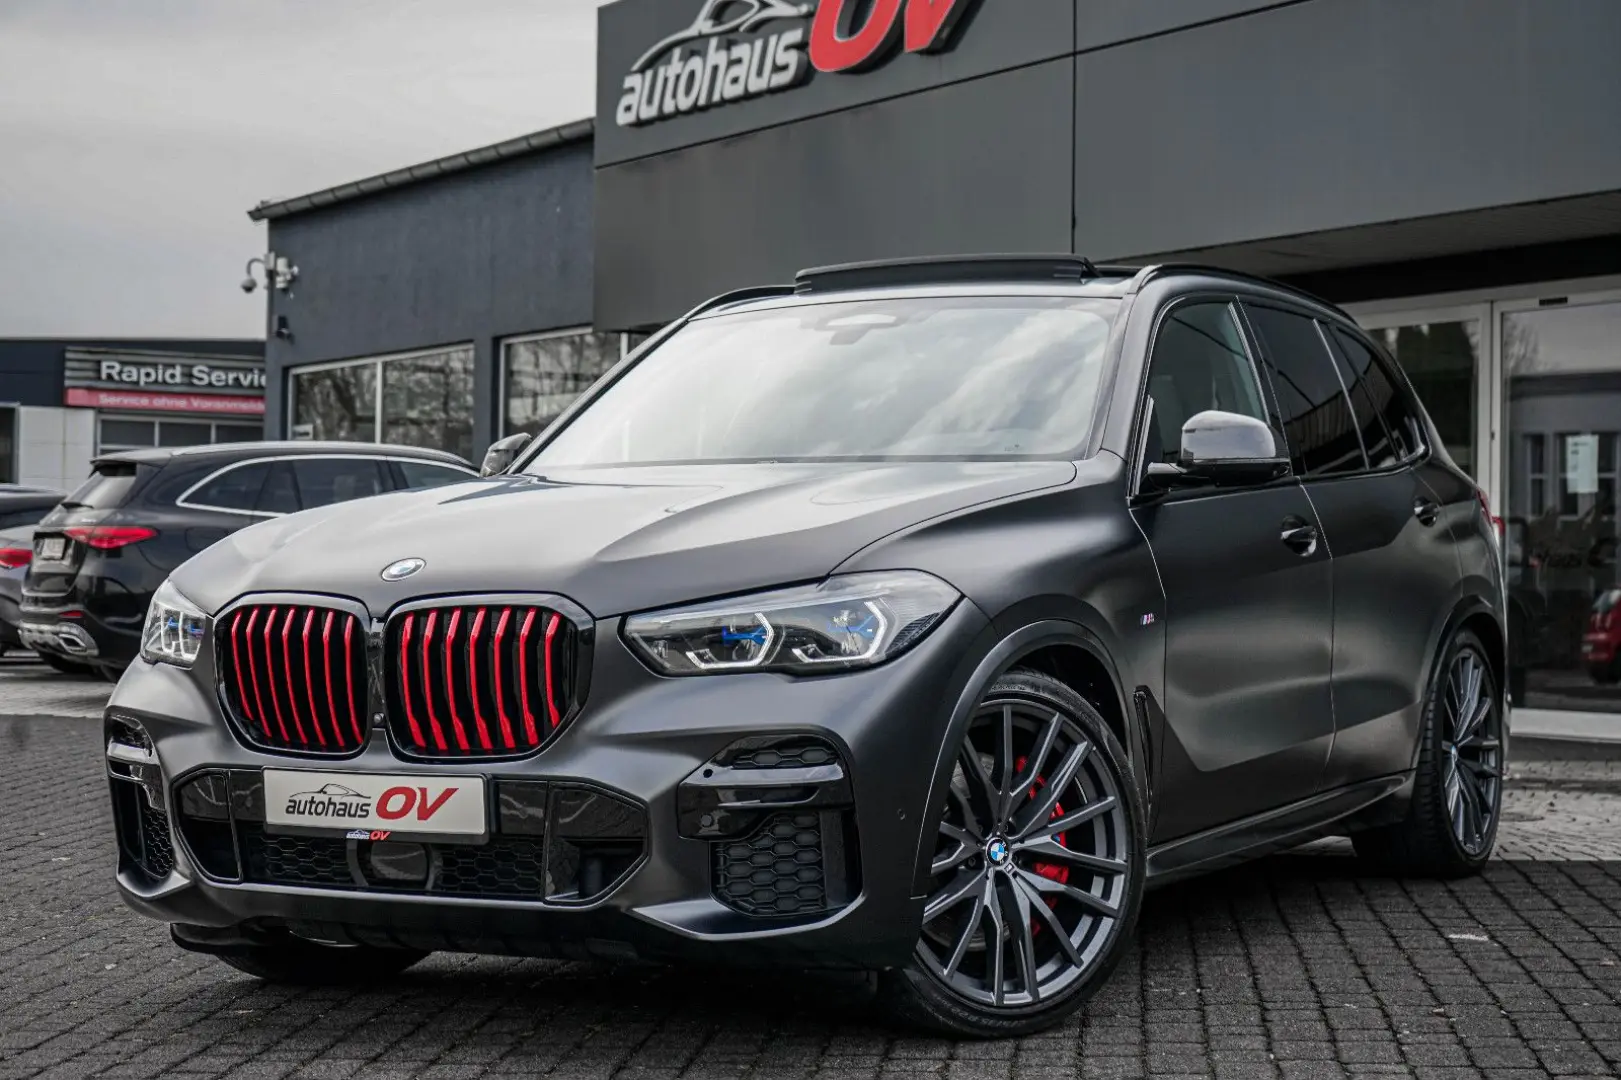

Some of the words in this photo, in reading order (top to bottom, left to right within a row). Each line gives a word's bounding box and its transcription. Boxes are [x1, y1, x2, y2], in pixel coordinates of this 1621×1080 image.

[616, 29, 803, 126] autohaus
[100, 361, 182, 386] Rapid
[98, 393, 149, 406] Service
[152, 396, 187, 408] ohne
[285, 796, 371, 818] autohaus
[375, 786, 459, 820] OV
[370, 830, 391, 840] OV
